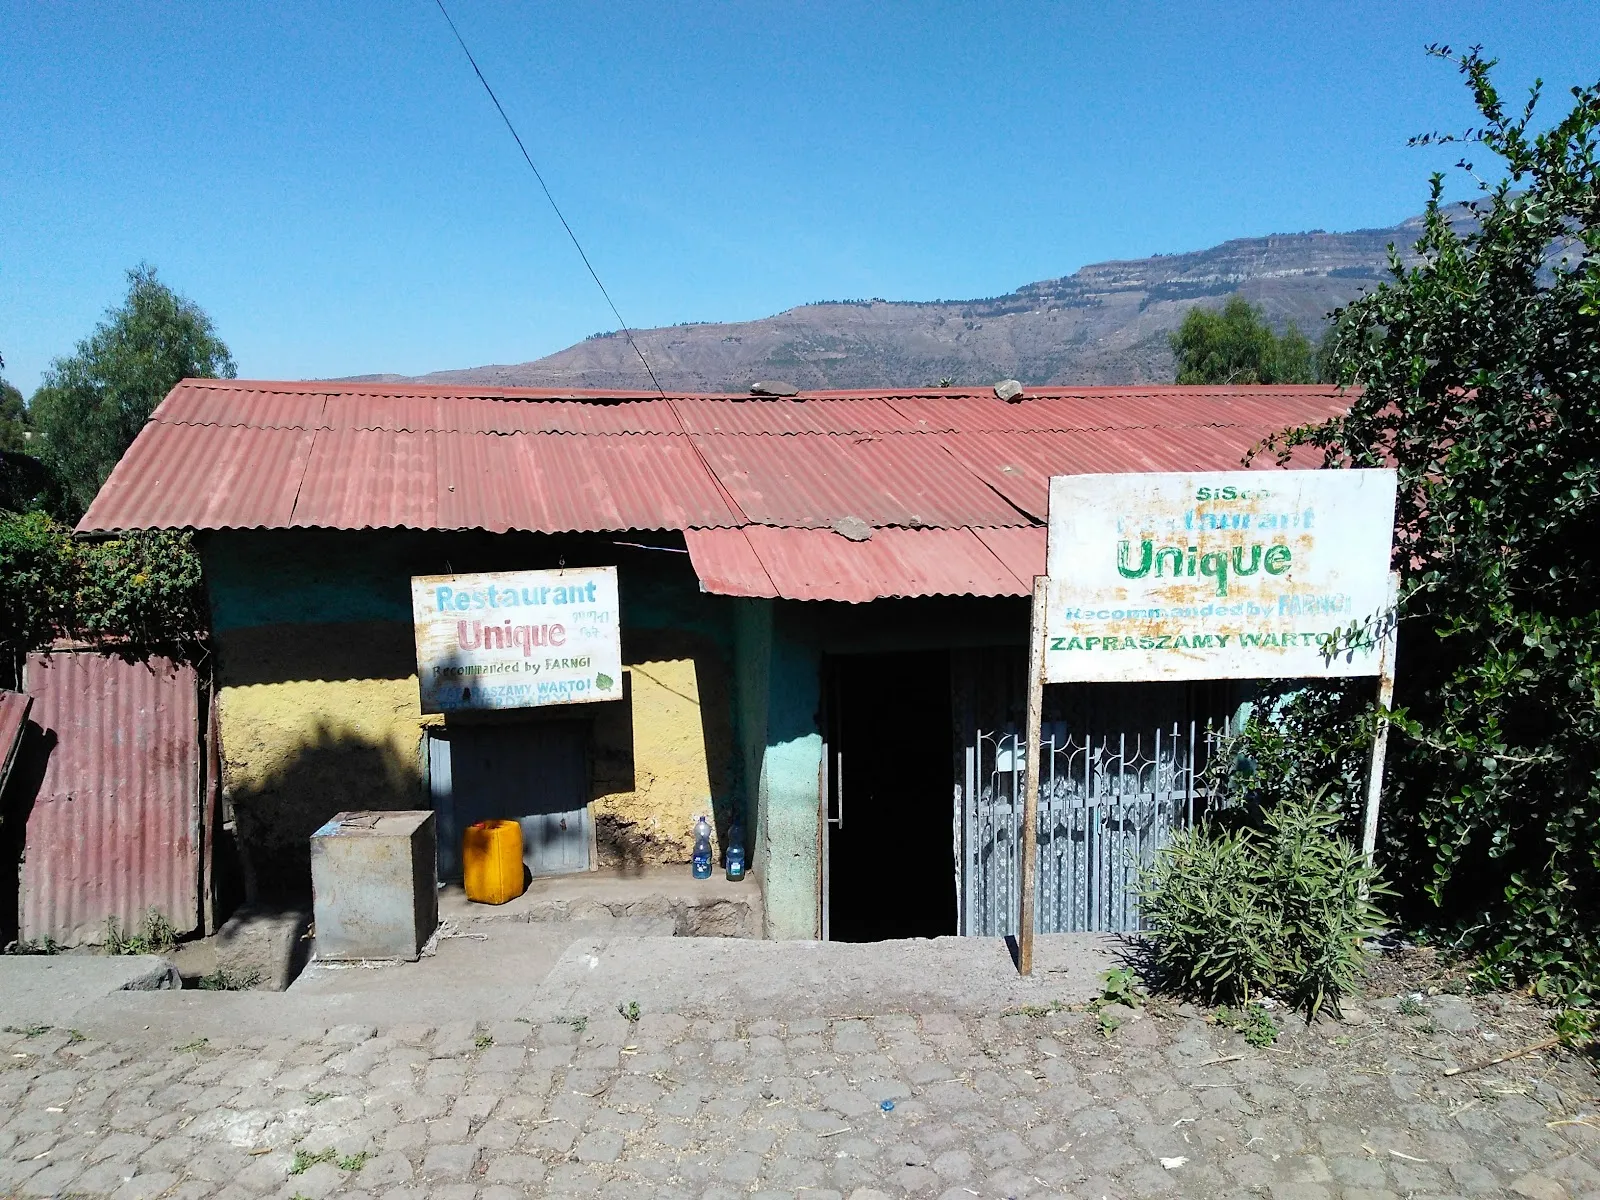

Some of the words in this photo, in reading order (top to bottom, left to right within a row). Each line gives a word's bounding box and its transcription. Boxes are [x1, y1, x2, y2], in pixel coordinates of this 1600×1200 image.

[1116, 538, 1292, 597] Unique
[435, 580, 597, 612] Restaurant
[457, 619, 566, 657] Unique
[1049, 634, 1231, 651] ZAPRASZAMY
[433, 660, 519, 678] Recommanded
[524, 661, 540, 675] by
[545, 657, 591, 670] FARNGI
[537, 678, 591, 694] WARTO!
